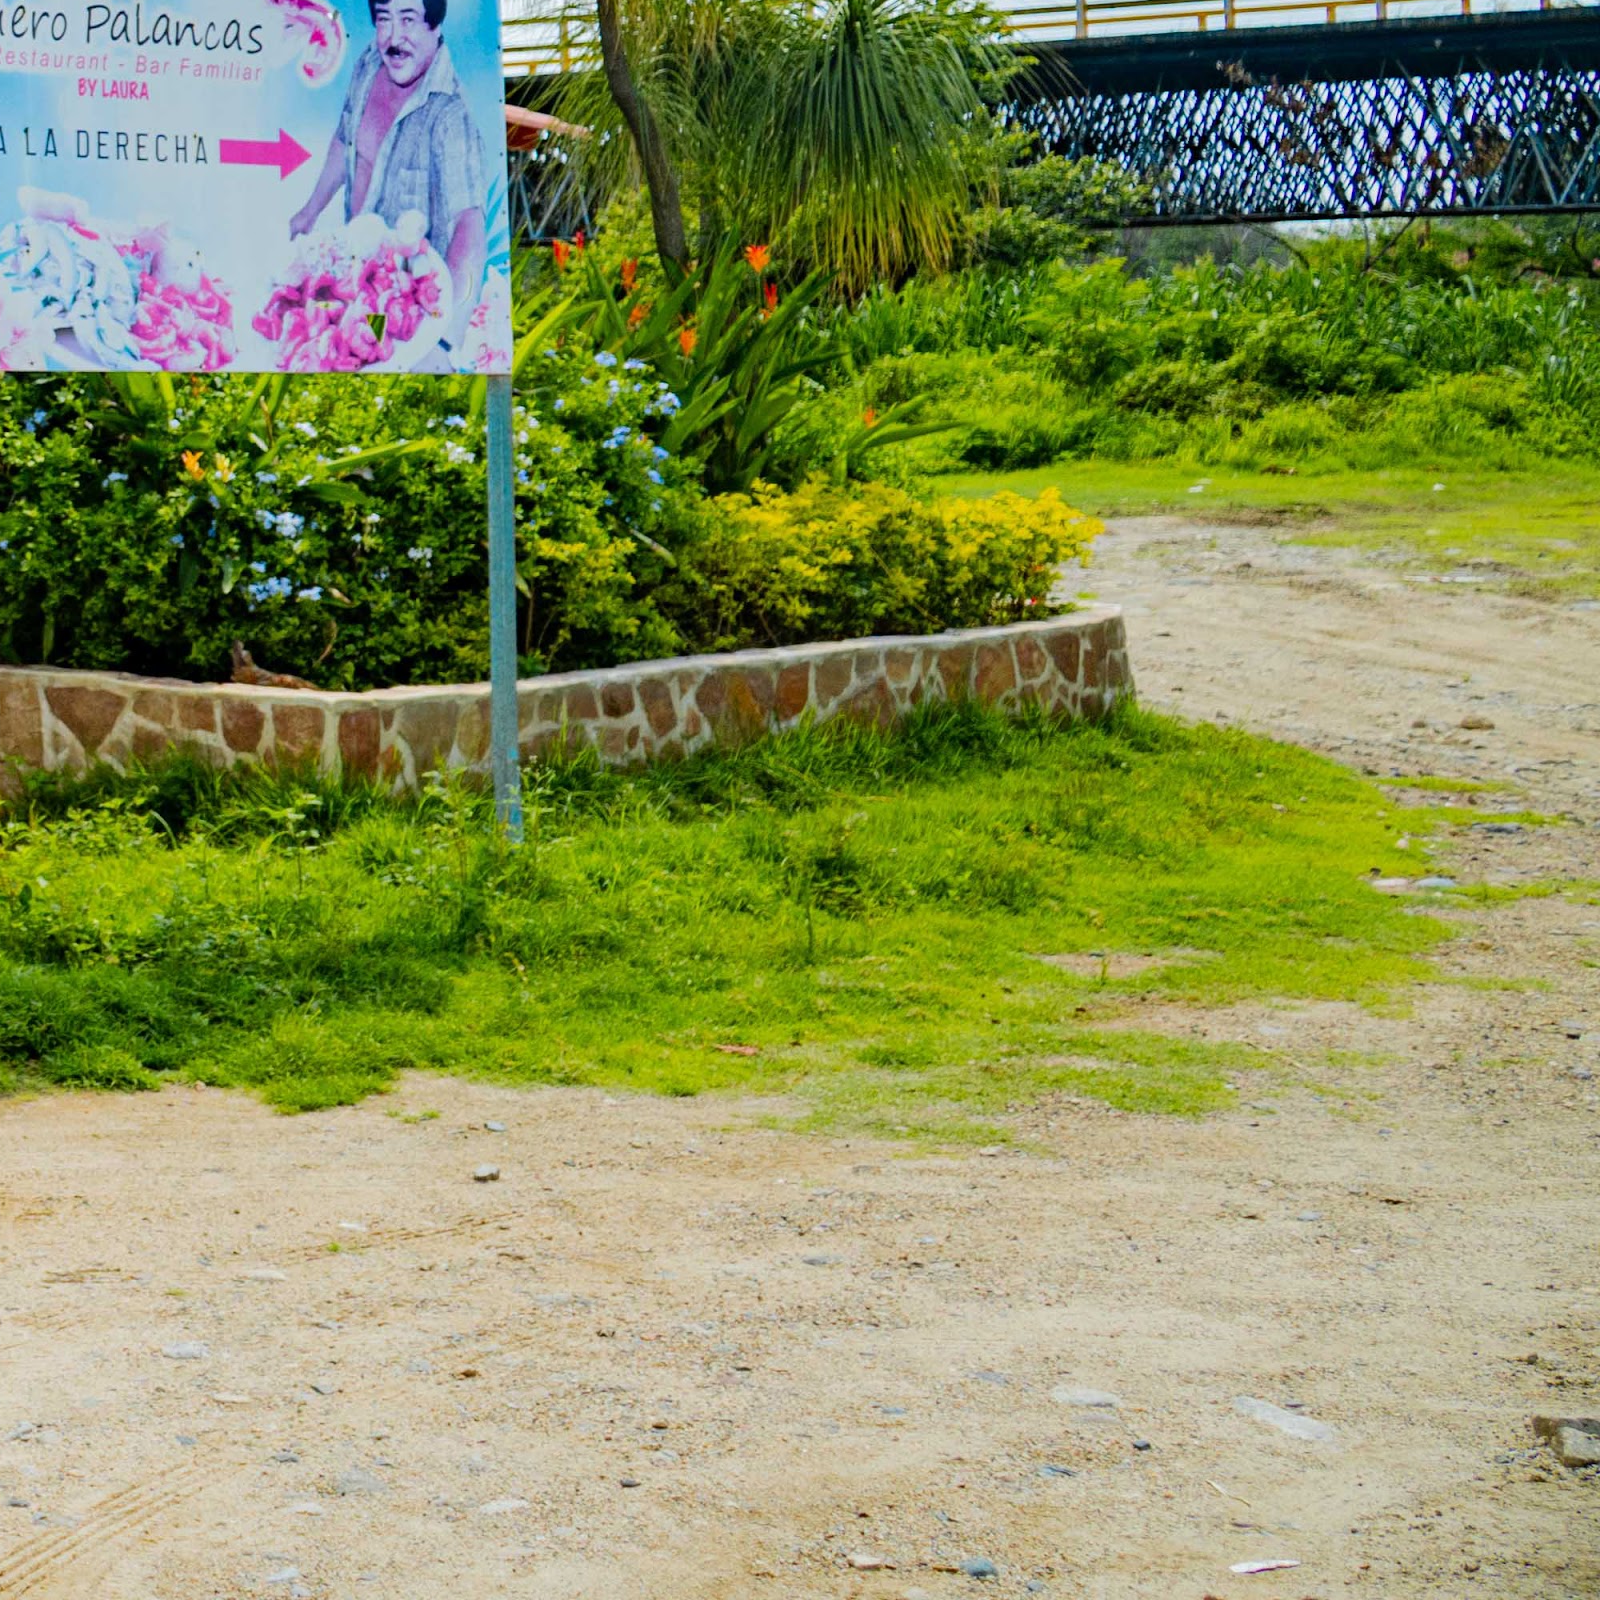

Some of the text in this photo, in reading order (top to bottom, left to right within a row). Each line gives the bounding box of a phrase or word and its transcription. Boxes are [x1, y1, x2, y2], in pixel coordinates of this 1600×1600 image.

[87, 3, 265, 55] Palancas
[136, 56, 170, 76] Bar
[180, 59, 263, 81] Familiar
[77, 77, 150, 100] BY LAURA
[25, 127, 58, 157] LA
[77, 130, 209, 164] DERECHA
